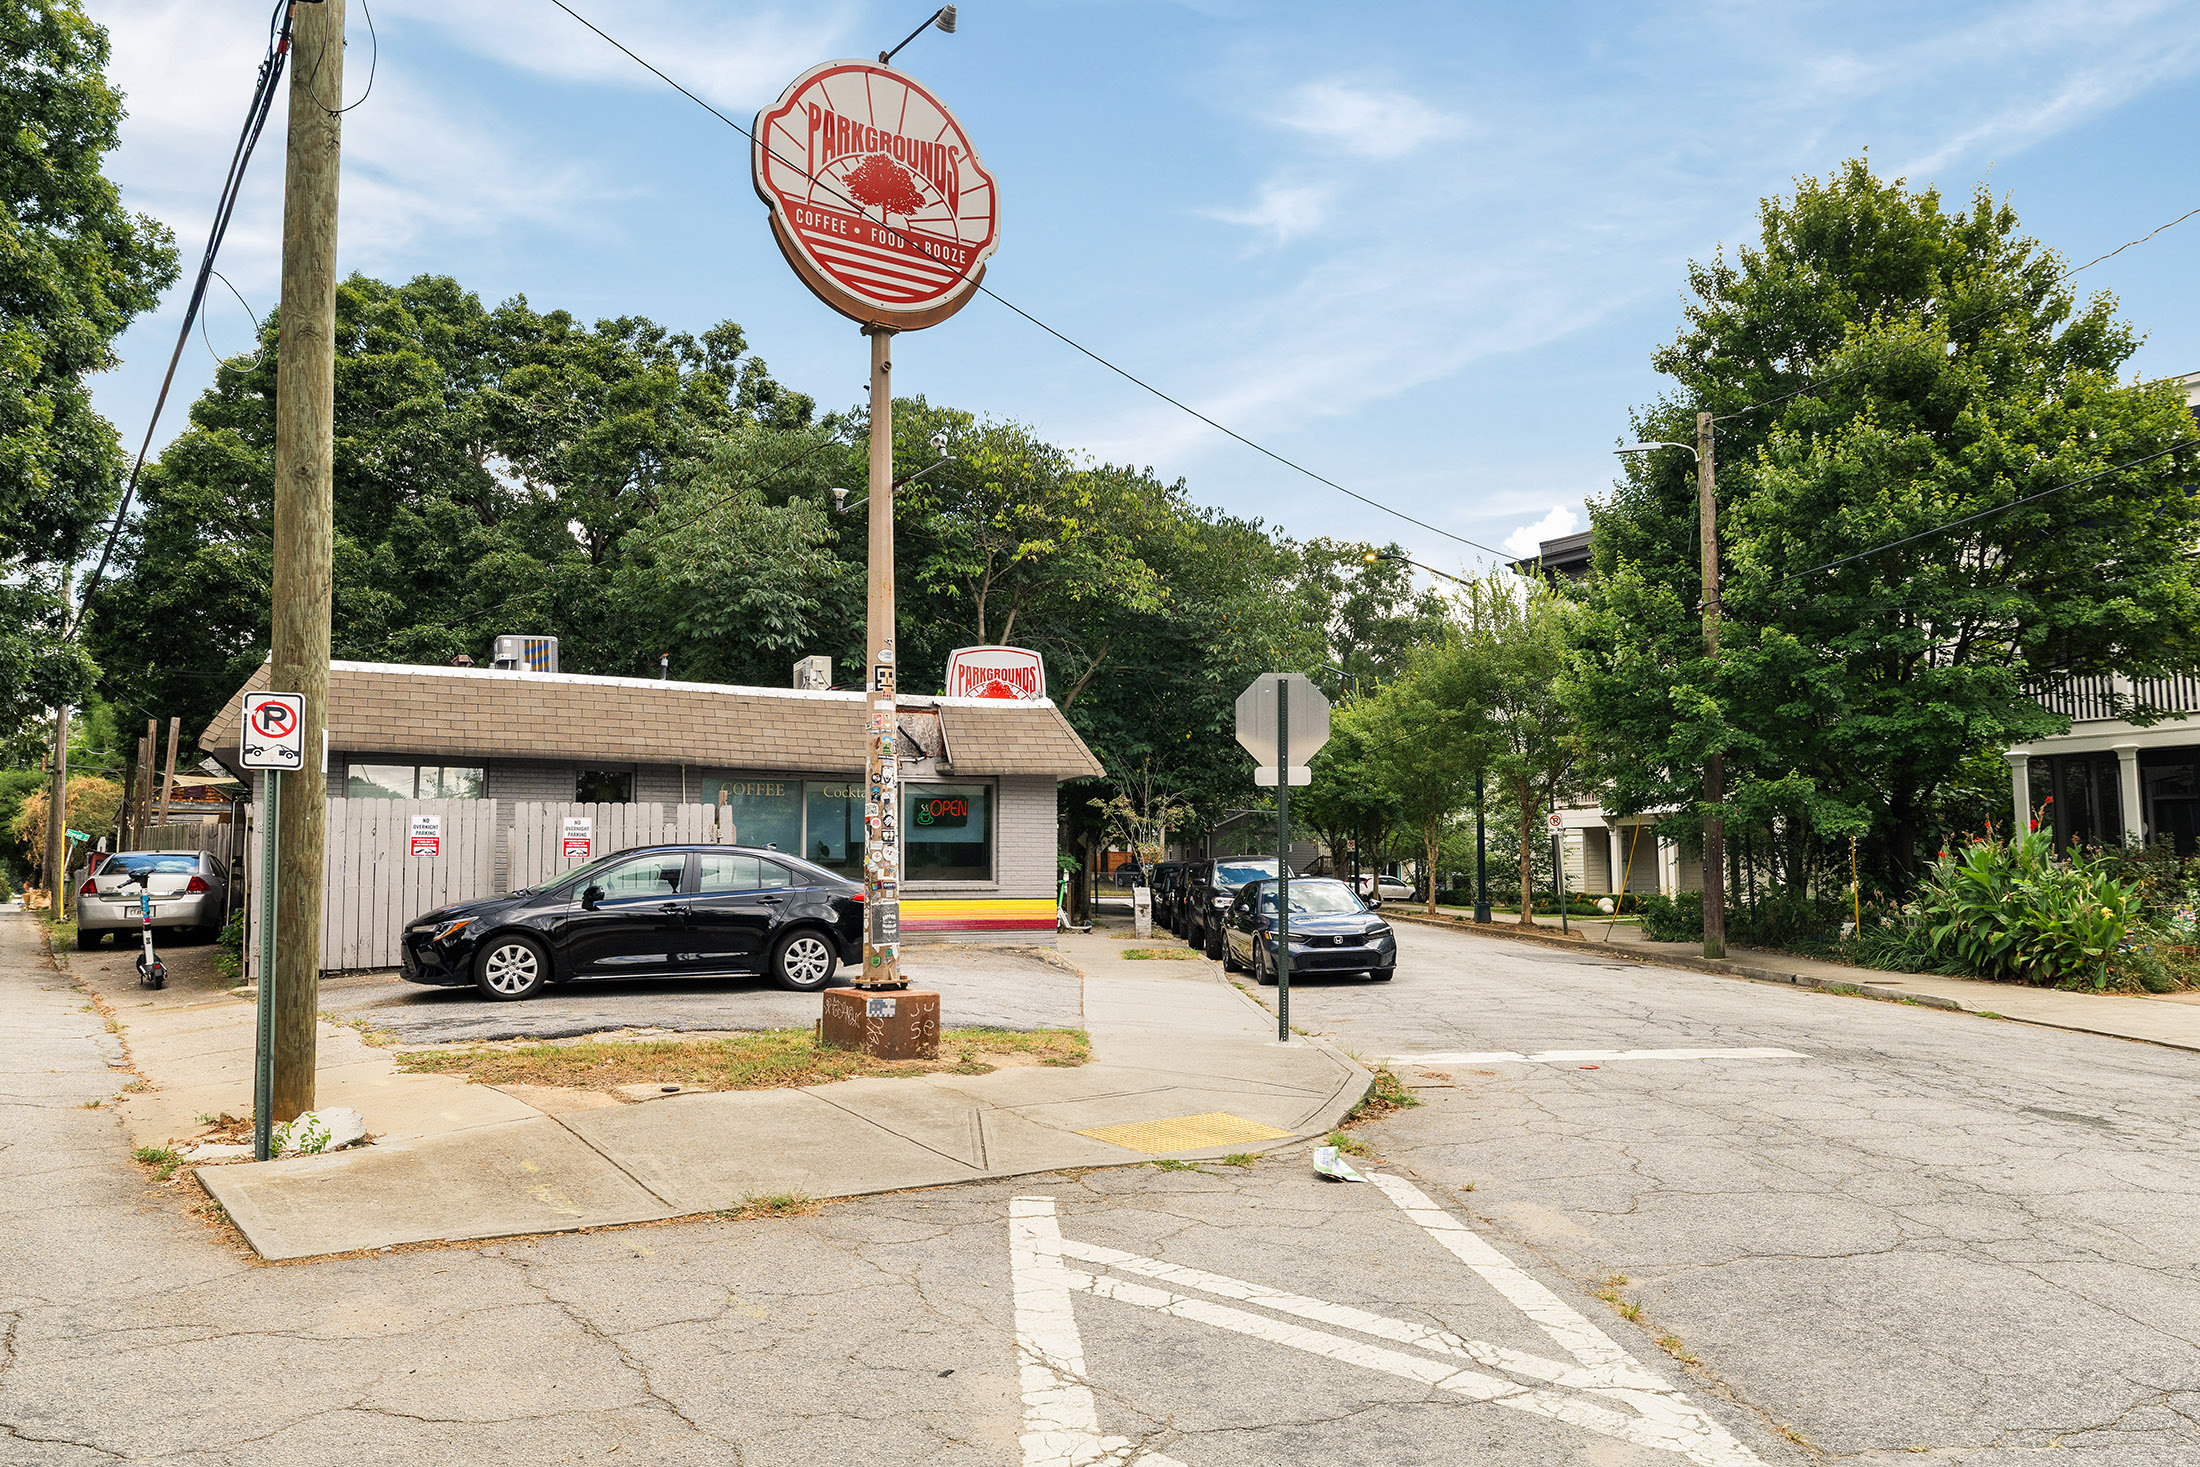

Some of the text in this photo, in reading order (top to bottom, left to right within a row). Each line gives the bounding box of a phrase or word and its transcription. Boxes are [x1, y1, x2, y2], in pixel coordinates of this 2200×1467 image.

[808, 101, 960, 218] PARKGROUNDS
[796, 208, 966, 264] COFFEE FOOD BOOZE
[959, 664, 1036, 697] PARKGROUNDS
[721, 782, 785, 796] COFFEE
[823, 784, 866, 798] Cockta
[930, 800, 967, 816] OPEN
